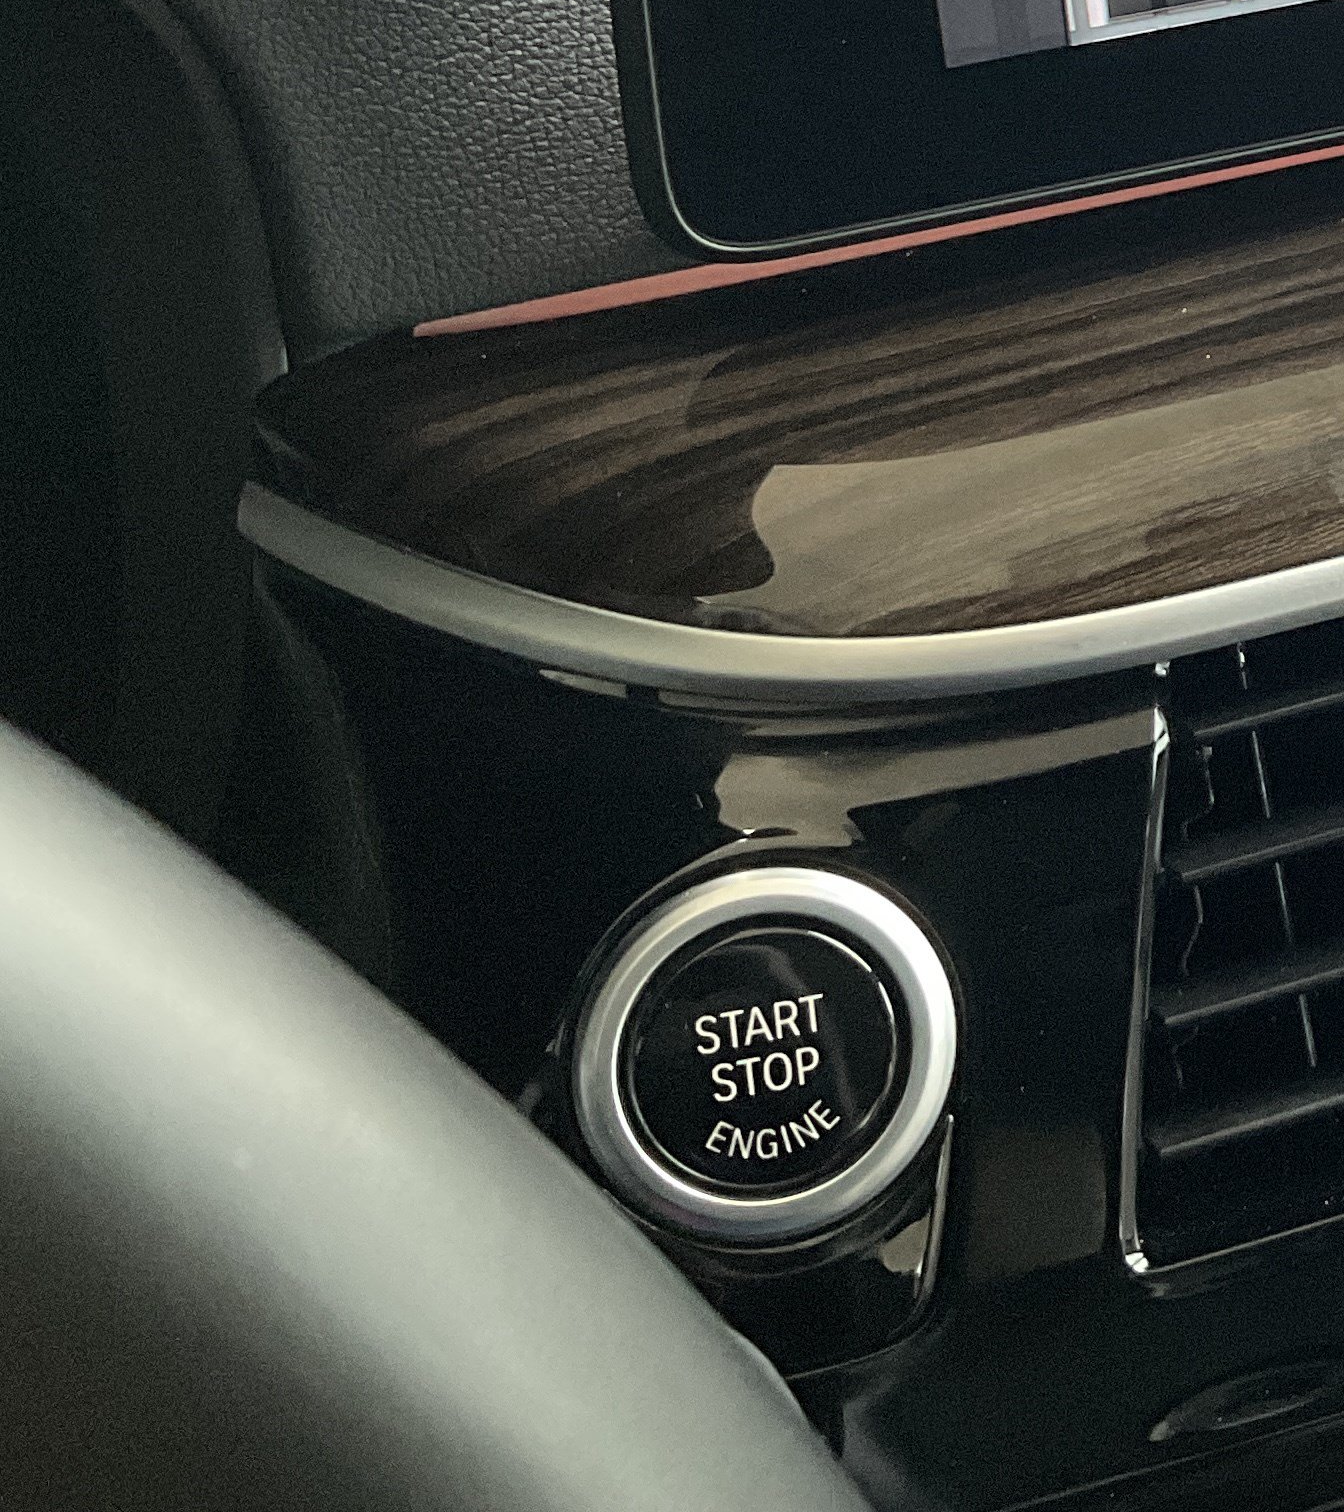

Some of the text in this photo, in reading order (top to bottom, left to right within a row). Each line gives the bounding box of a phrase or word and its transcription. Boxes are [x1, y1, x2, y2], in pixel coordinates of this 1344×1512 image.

[695, 993, 824, 1054] START
[711, 1046, 820, 1102] STOP
[704, 1100, 841, 1160] ENGINE
